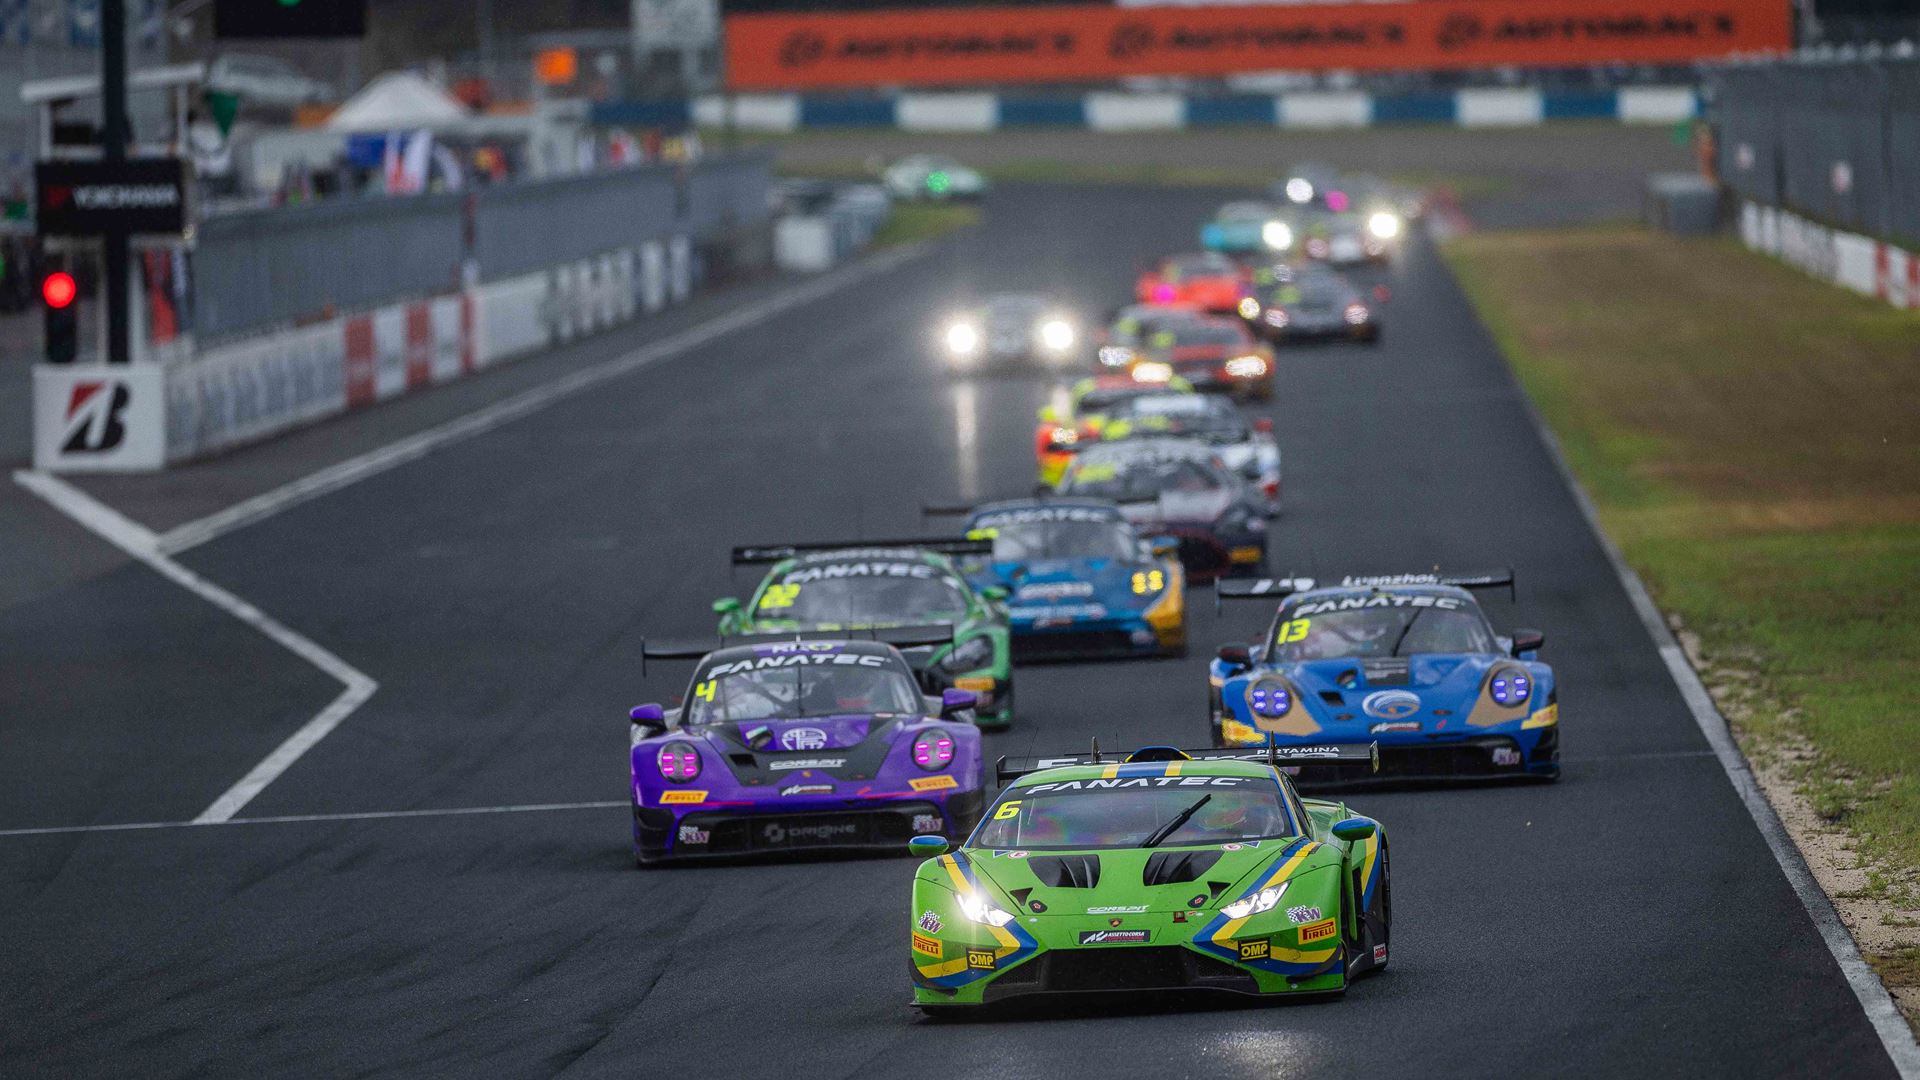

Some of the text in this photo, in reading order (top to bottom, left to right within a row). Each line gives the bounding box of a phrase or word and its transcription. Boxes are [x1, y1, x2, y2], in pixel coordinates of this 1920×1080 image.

[783, 563, 931, 587] FANATEC
[1293, 597, 1460, 619] FANATEC
[1278, 618, 1311, 645] 13
[707, 654, 887, 680] FANATEC
[695, 680, 718, 702] 4
[1026, 777, 1242, 795] FANATEC
[993, 800, 1022, 819] 6
[1295, 908, 1321, 922] KW
[1302, 921, 1334, 941] PIRELLI
[969, 954, 994, 966] OMP
[1241, 944, 1268, 957] OMP
